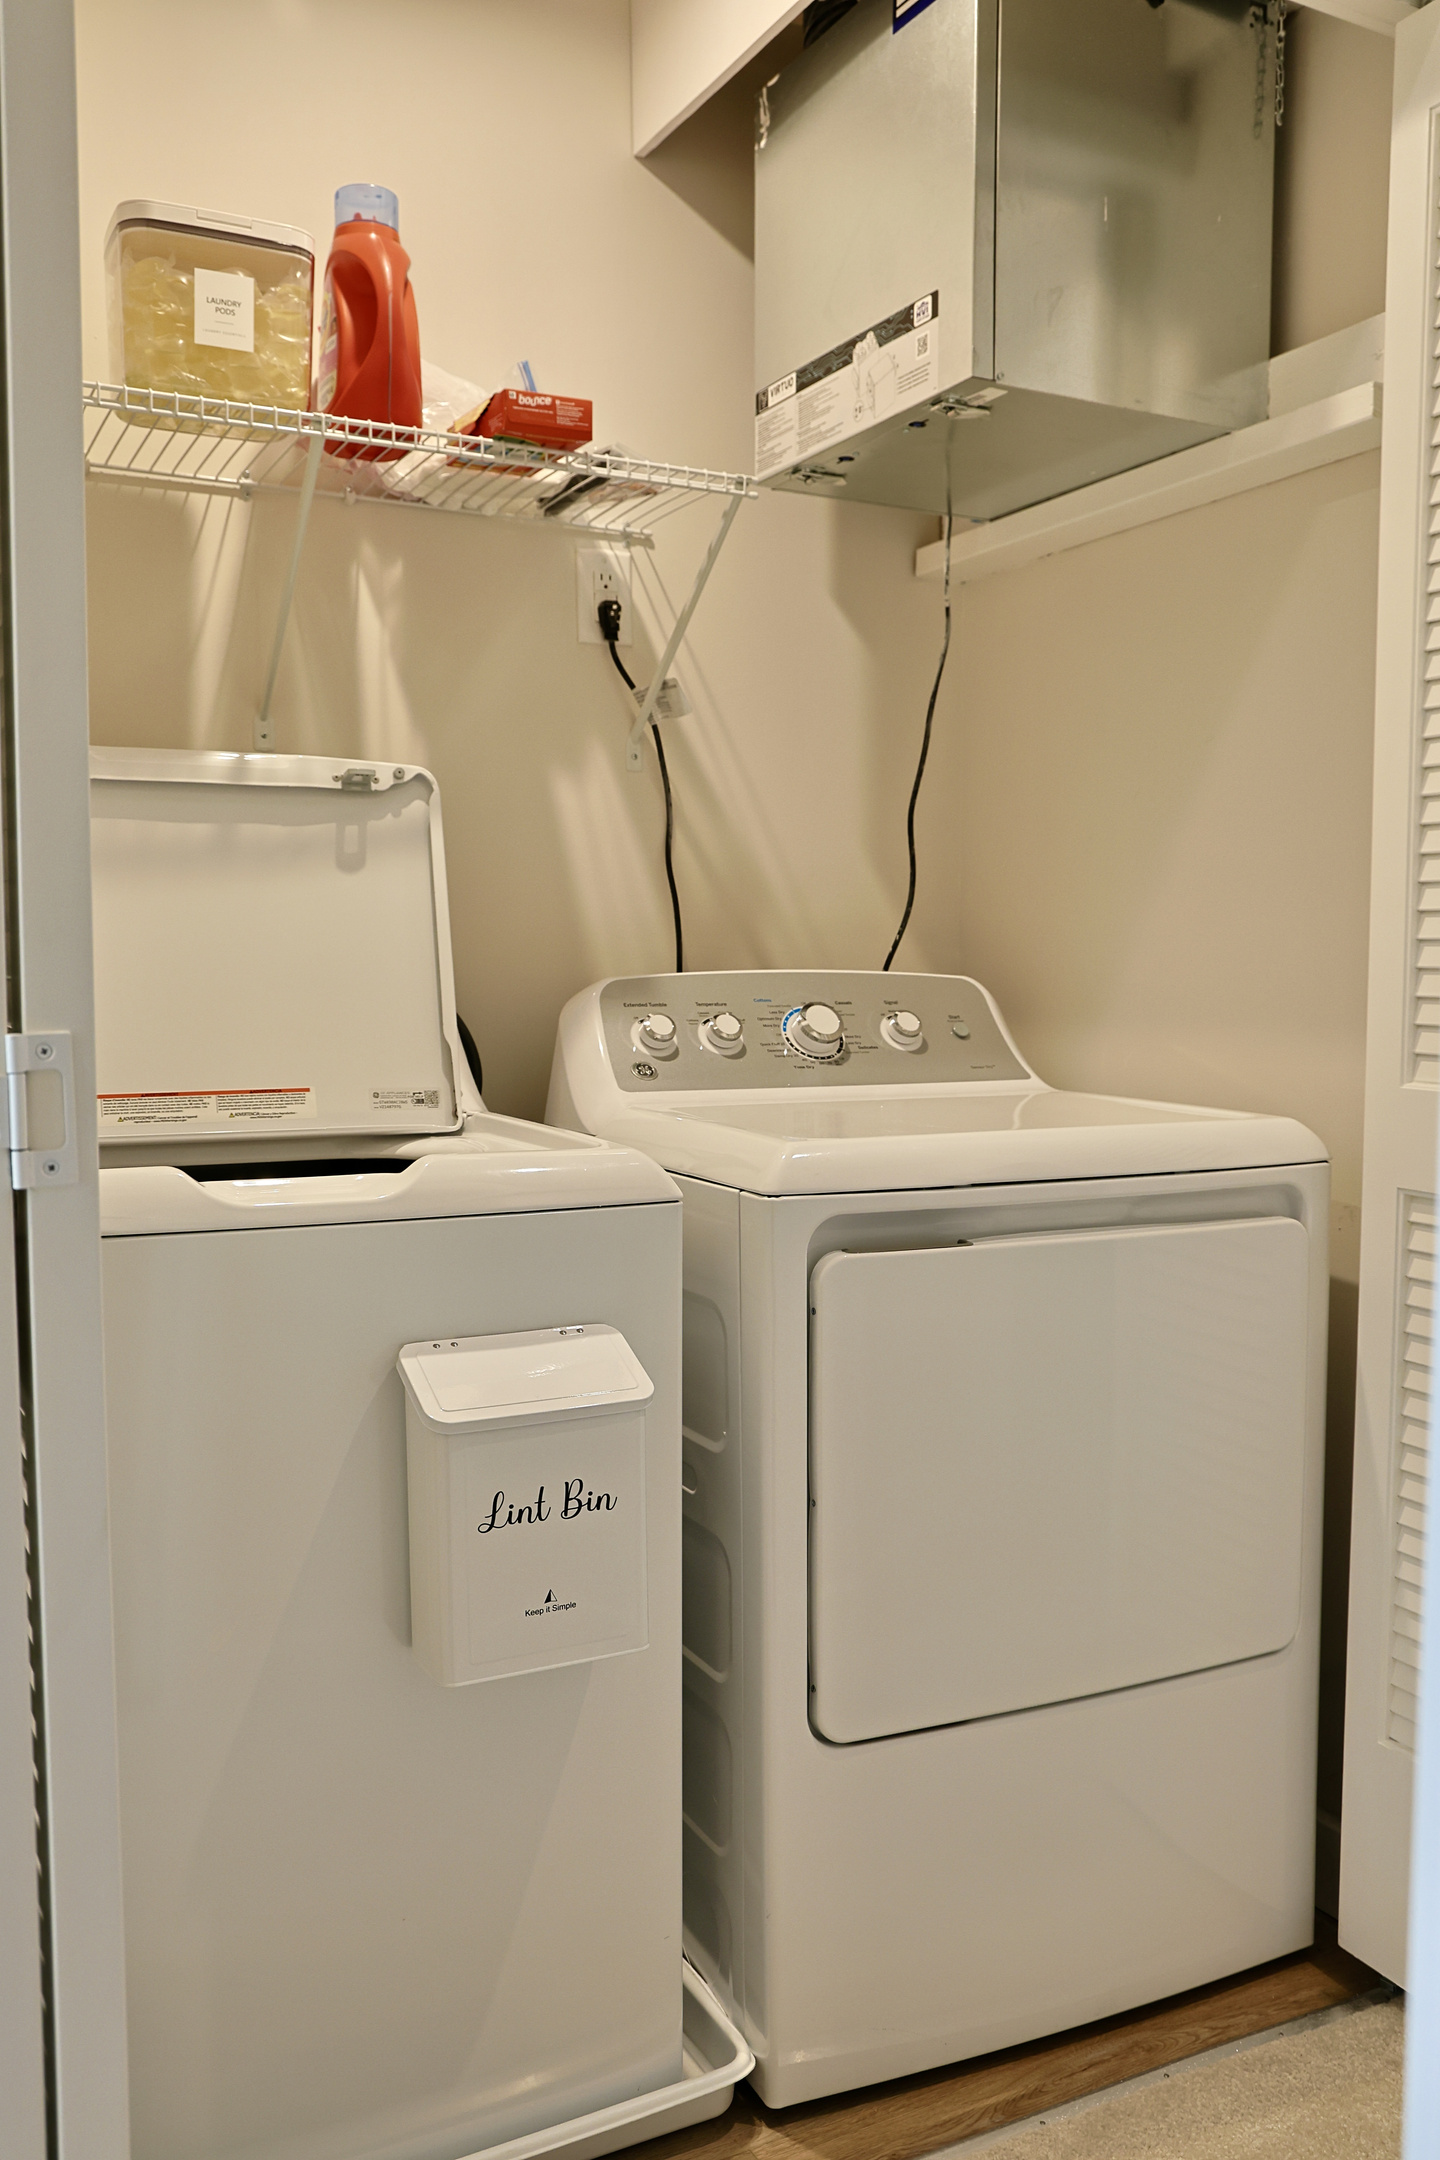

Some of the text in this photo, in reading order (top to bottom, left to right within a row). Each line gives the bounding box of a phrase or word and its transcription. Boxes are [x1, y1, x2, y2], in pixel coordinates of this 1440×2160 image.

[206, 296, 242, 308] LAUNDRY
[215, 306, 236, 316] PODS
[770, 376, 794, 398] VIRTUO
[518, 393, 552, 406] bounce
[477, 1478, 618, 1534] Lint Bin
[524, 1608, 545, 1617] Keep
[551, 1601, 577, 1612] Simple
